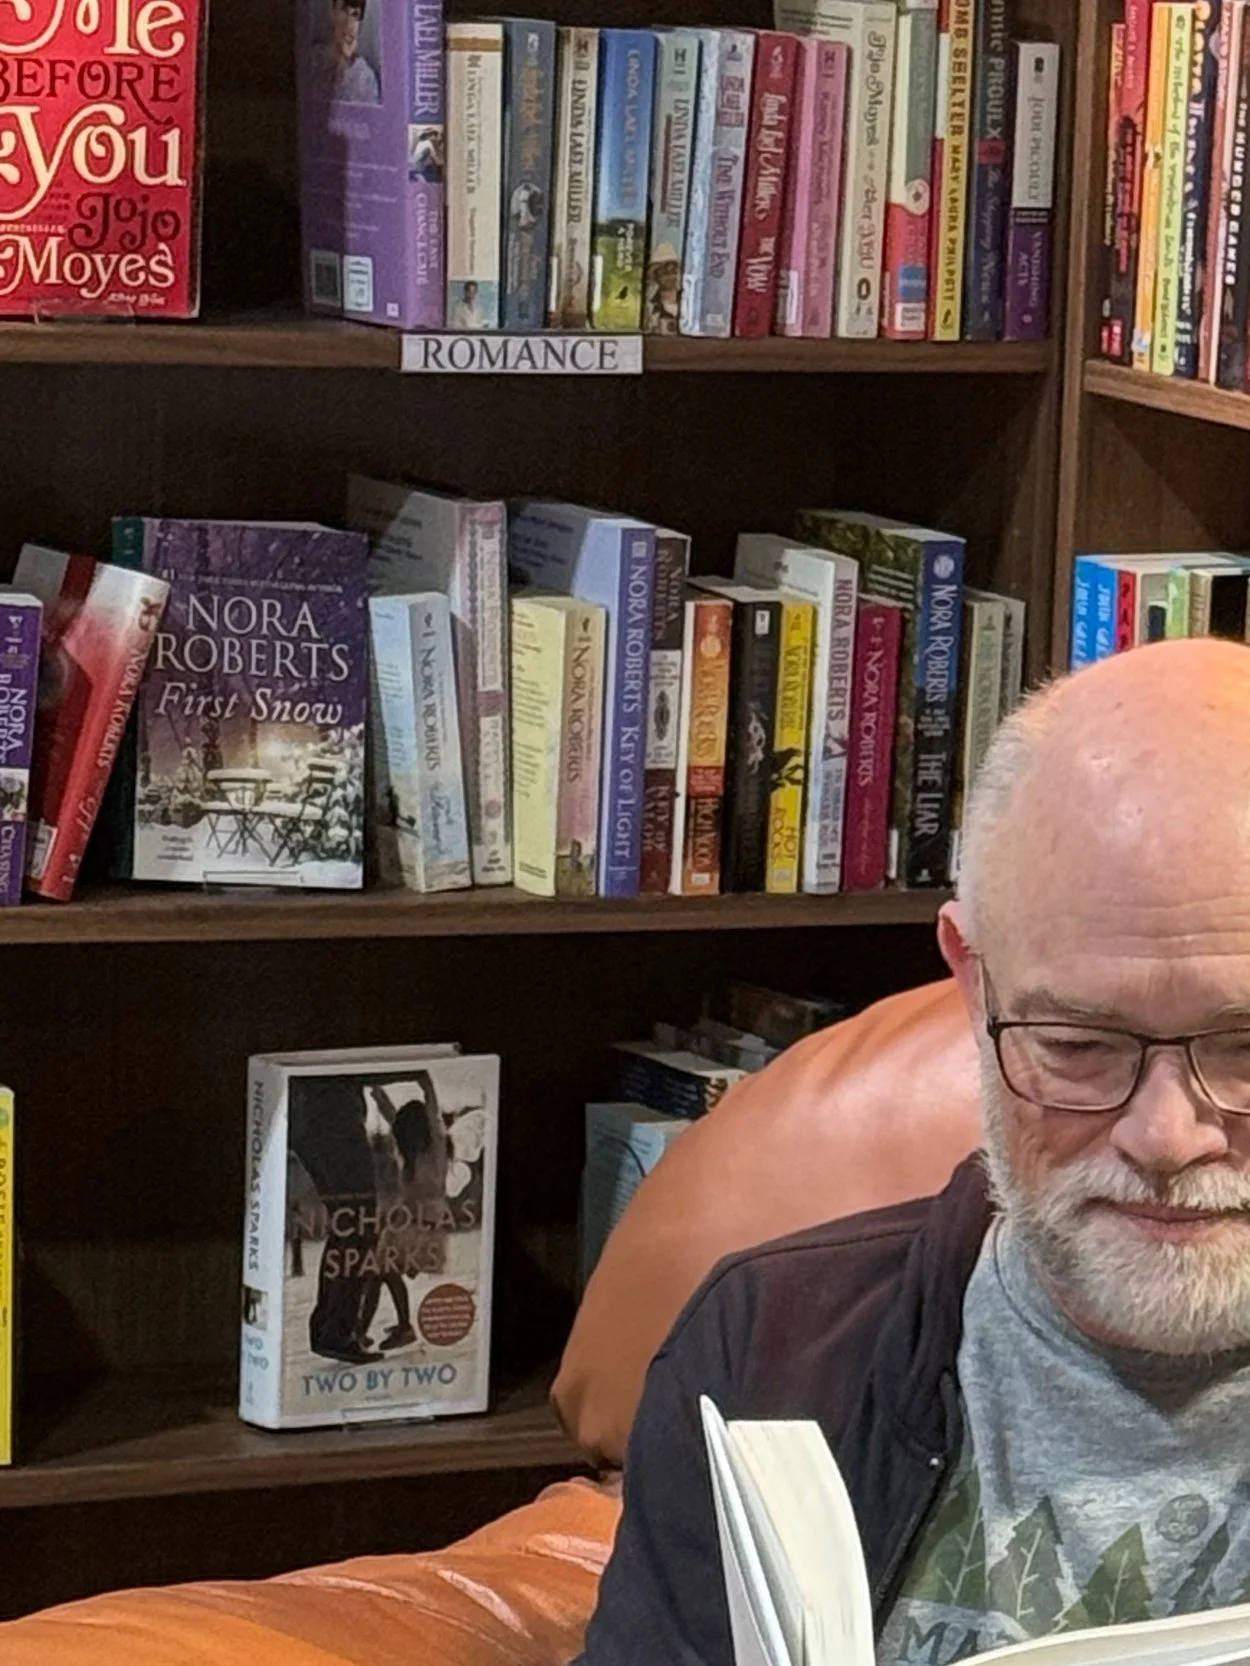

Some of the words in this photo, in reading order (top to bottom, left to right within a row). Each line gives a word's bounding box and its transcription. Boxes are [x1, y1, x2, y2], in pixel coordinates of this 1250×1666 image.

[413, 50, 443, 117] MILLER
[571, 79, 588, 128] LINDA
[951, 47, 969, 137] SHELTER
[985, 56, 1006, 140] PROULX
[674, 98, 690, 141] LINDA
[569, 130, 587, 165] LAEL
[671, 143, 688, 179] LAEL
[949, 143, 963, 183] MARY
[1230, 131, 1247, 217] HUNGER
[68, 191, 182, 250] Jojo
[567, 170, 584, 224] MILLER
[666, 180, 685, 229] MILLER
[1224, 220, 1241, 286] GAMES
[420, 336, 620, 371] ROMANCE
[185, 593, 321, 639] NORA
[627, 564, 649, 627] NORA
[832, 578, 853, 630] NORA
[927, 584, 957, 635] NORA
[117, 652, 149, 696] NORA
[154, 632, 350, 682] ROBERTS
[420, 646, 438, 709] NORA
[569, 646, 589, 701] NORA
[623, 628, 648, 713] ROBERTS
[826, 635, 851, 722] ROBERTS
[862, 649, 884, 708] NORA
[922, 635, 954, 703] ROBERTS
[6, 687, 28, 753] NORA
[154, 681, 240, 720] First
[250, 687, 343, 725] Snow
[97, 697, 135, 767] ROBERTS
[566, 707, 584, 783] ROBERTS
[619, 725, 640, 764] KEY
[856, 711, 880, 787] ROBERTS
[619, 767, 633, 794] OF
[917, 750, 948, 789] THE
[614, 797, 636, 859] LIGHT
[914, 792, 945, 838] LIAR
[249, 1080, 265, 1193] NICHOLAS
[247, 1200, 262, 1271] SPARKS
[291, 1199, 477, 1240] NICHOLAS
[322, 1241, 441, 1279] SPARKS
[300, 1371, 358, 1397] TWO
[365, 1368, 395, 1392] BY
[402, 1363, 458, 1388] TWO
